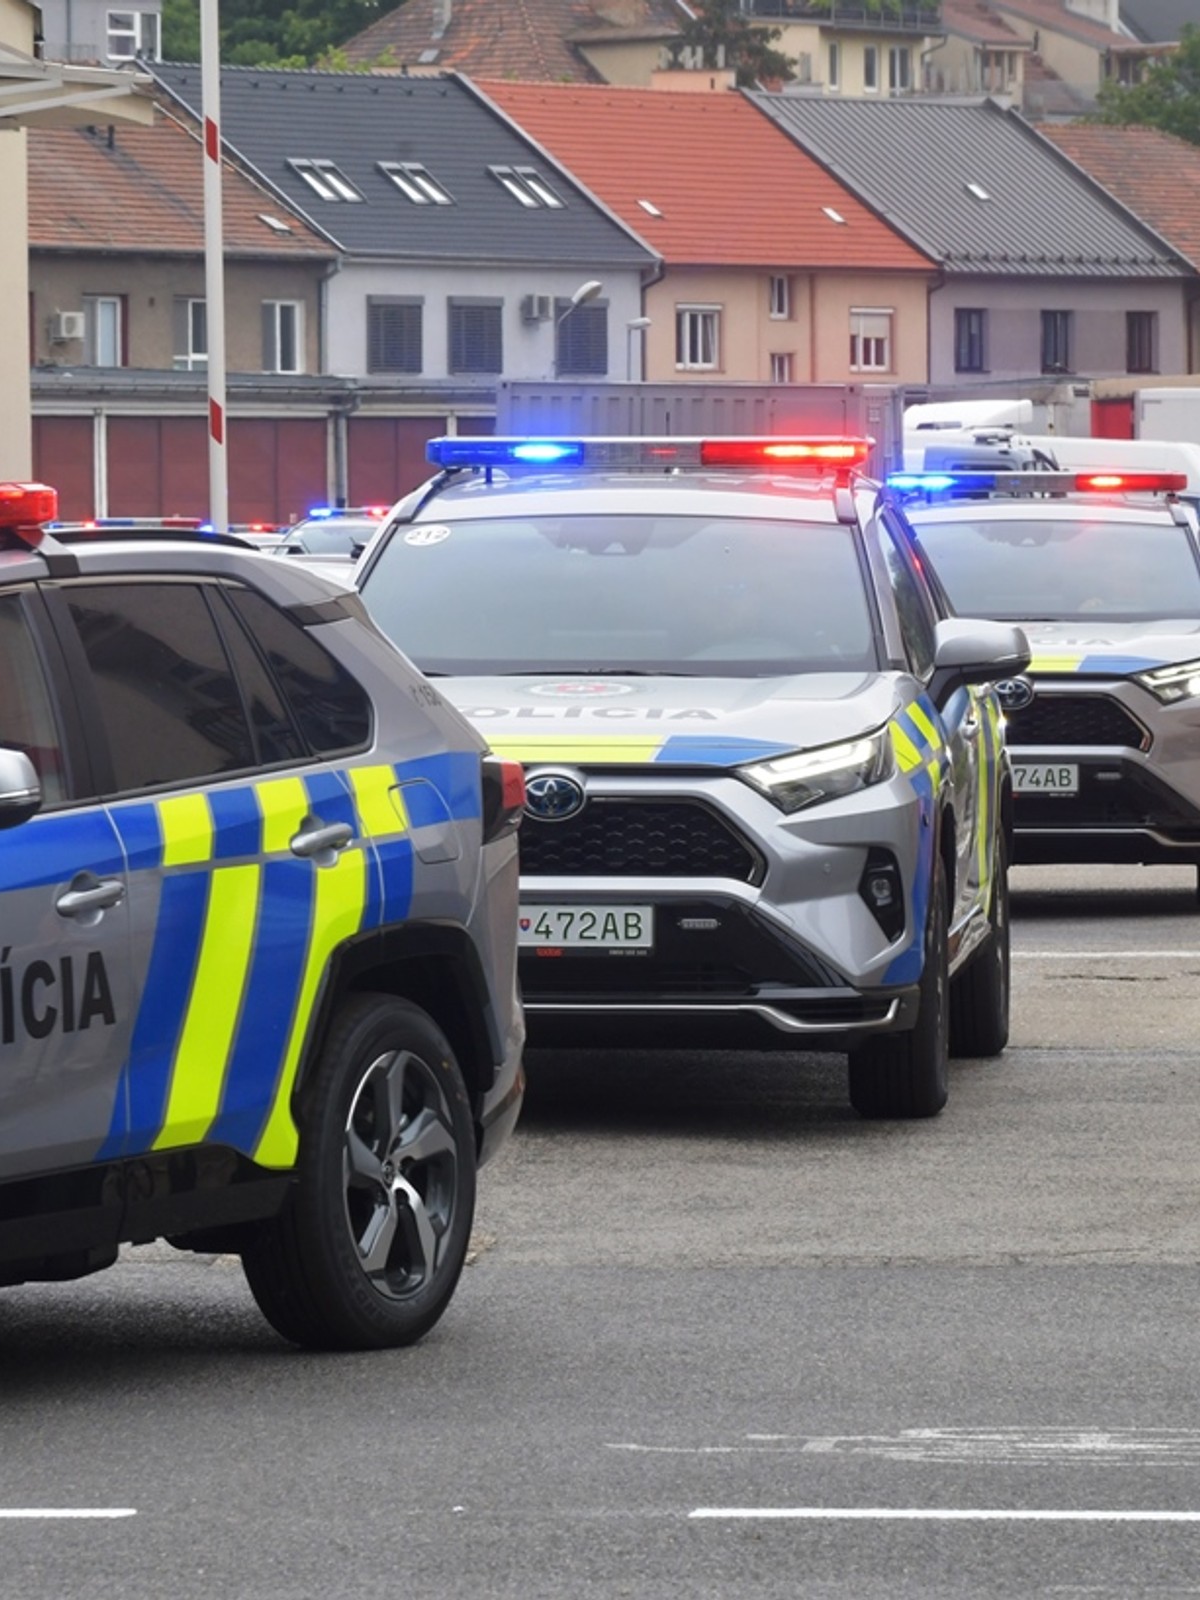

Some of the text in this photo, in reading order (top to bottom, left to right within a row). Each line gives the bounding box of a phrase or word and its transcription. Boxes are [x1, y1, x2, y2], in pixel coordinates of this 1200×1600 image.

[460, 705, 719, 721] OLÍCIA
[1014, 767, 1073, 788] 74AB
[533, 911, 643, 940] 472AB
